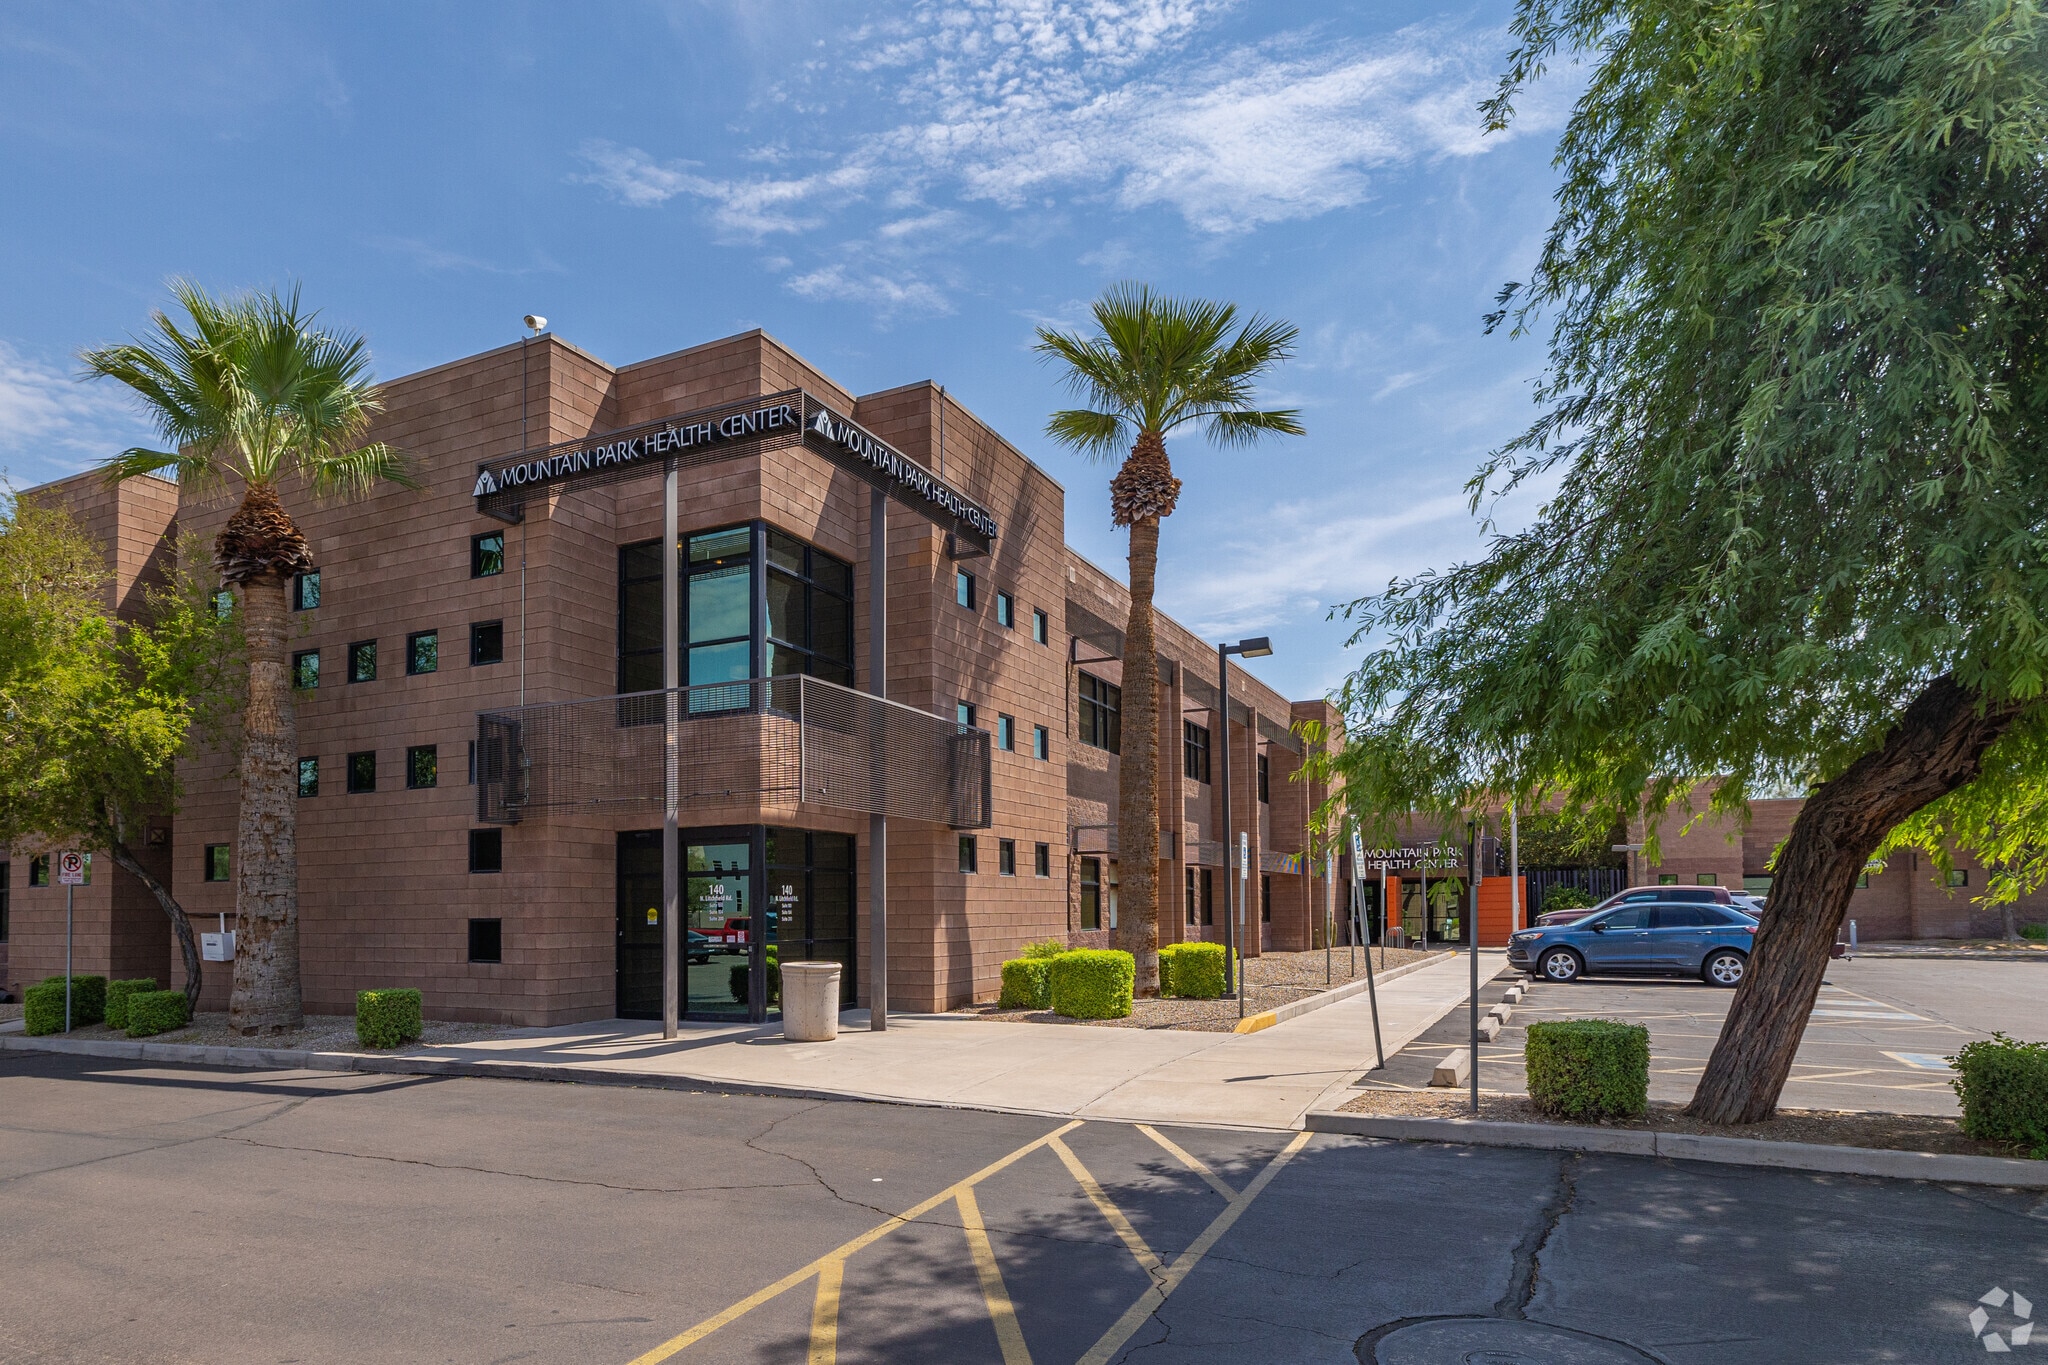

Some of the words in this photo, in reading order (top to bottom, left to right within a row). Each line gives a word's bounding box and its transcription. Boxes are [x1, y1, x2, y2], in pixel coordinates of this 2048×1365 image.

[500, 449, 591, 488] MOUNTAIN
[596, 437, 640, 467] PARK
[644, 421, 712, 455] HEALTH
[719, 404, 798, 437] CENTER
[837, 422, 903, 483] MOUNTAIN
[905, 464, 931, 500] PARK
[932, 483, 966, 519] HEALTH
[967, 507, 998, 537] CENTER
[1364, 847, 1429, 859] MOUNTAIN
[1368, 860, 1411, 870] HEALTH
[1415, 859, 1459, 869] CNER
[709, 884, 724, 895] 140
[781, 884, 793, 896] 140
